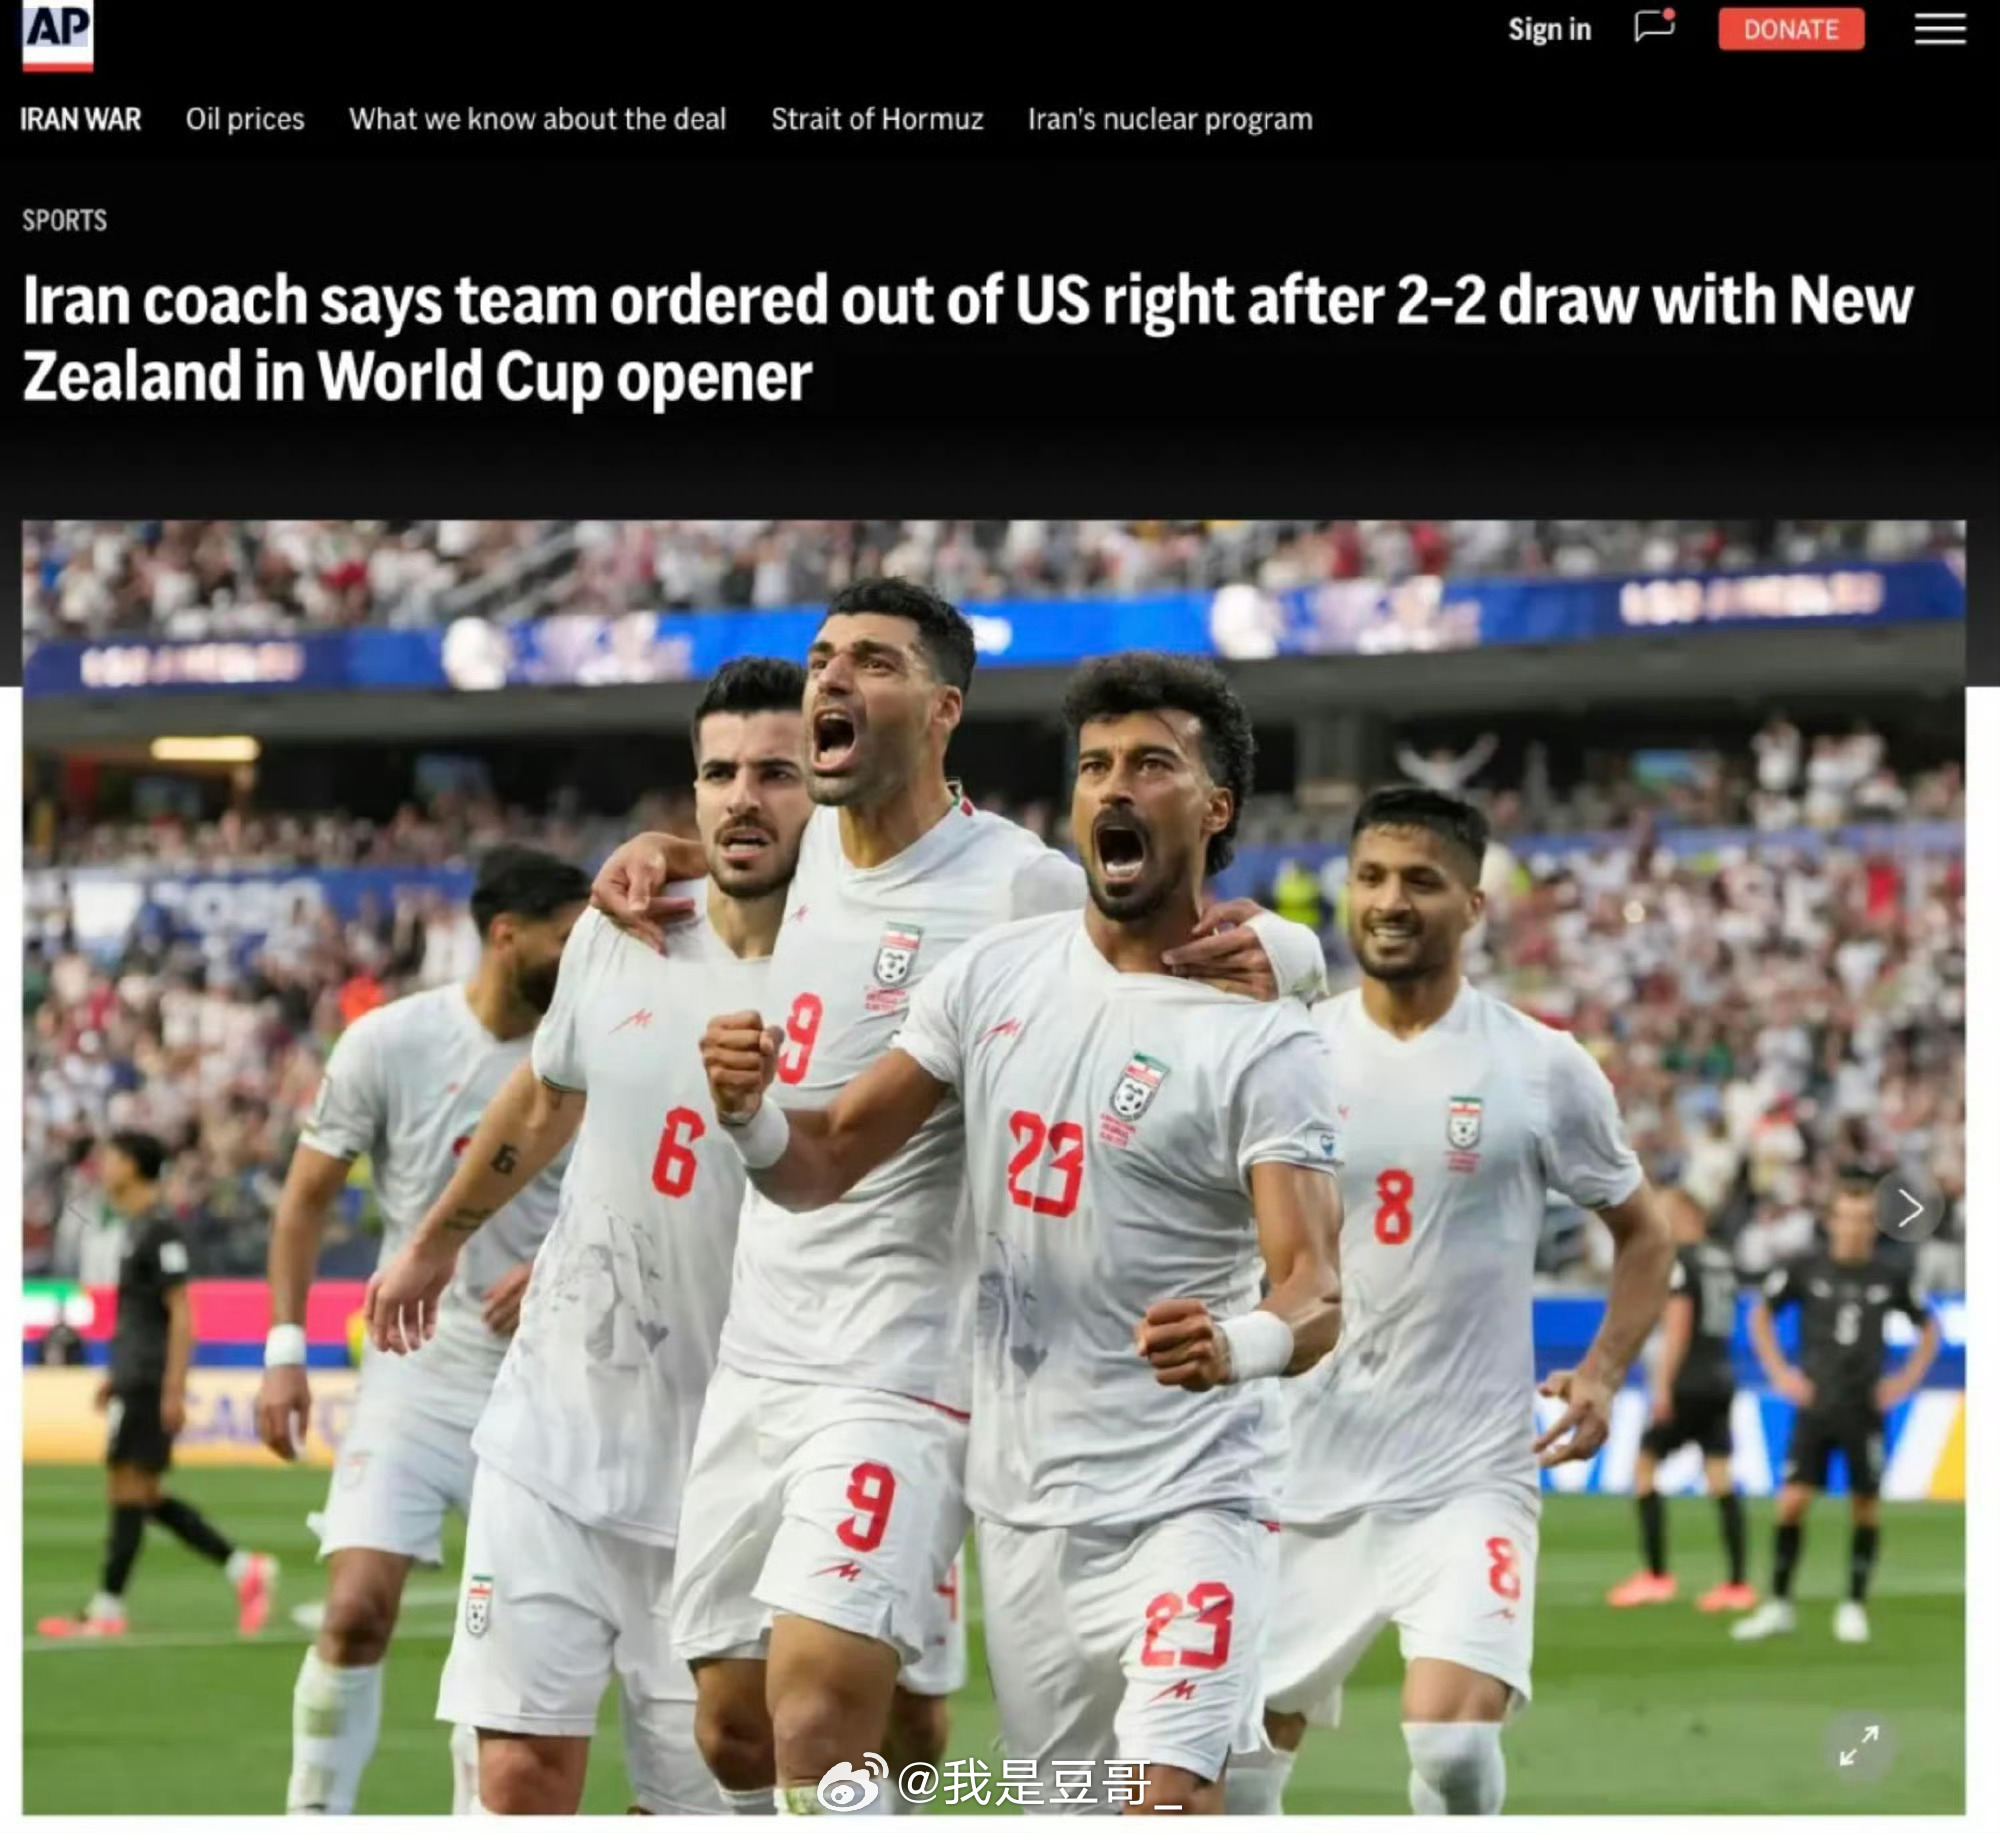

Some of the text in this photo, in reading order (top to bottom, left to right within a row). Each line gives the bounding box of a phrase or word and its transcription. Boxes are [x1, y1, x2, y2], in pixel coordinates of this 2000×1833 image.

[26, 6, 91, 45] AP
[1509, 16, 1592, 47] Sign in
[1744, 18, 1840, 41] DONATE
[20, 106, 142, 131] IRAN WAR
[186, 106, 305, 136] Oil prices
[349, 106, 726, 131] What we know about the deal
[772, 106, 984, 131] Strait of Hormuz
[1029, 106, 1313, 136] Iran's nuclear program
[22, 208, 108, 232] SPORTS
[25, 270, 1916, 339] Iran coach says team ordered out of US right after 2-2 draw with New
[23, 347, 814, 415] Zealand in World Cup opener
[777, 992, 823, 1085] 9
[652, 1106, 706, 1199] 6
[1007, 1110, 1085, 1218] 23
[1374, 1169, 1415, 1245] 8
[836, 1461, 897, 1553] 9
[1486, 1537, 1521, 1600] 8
[1141, 1582, 1235, 1670] 23
